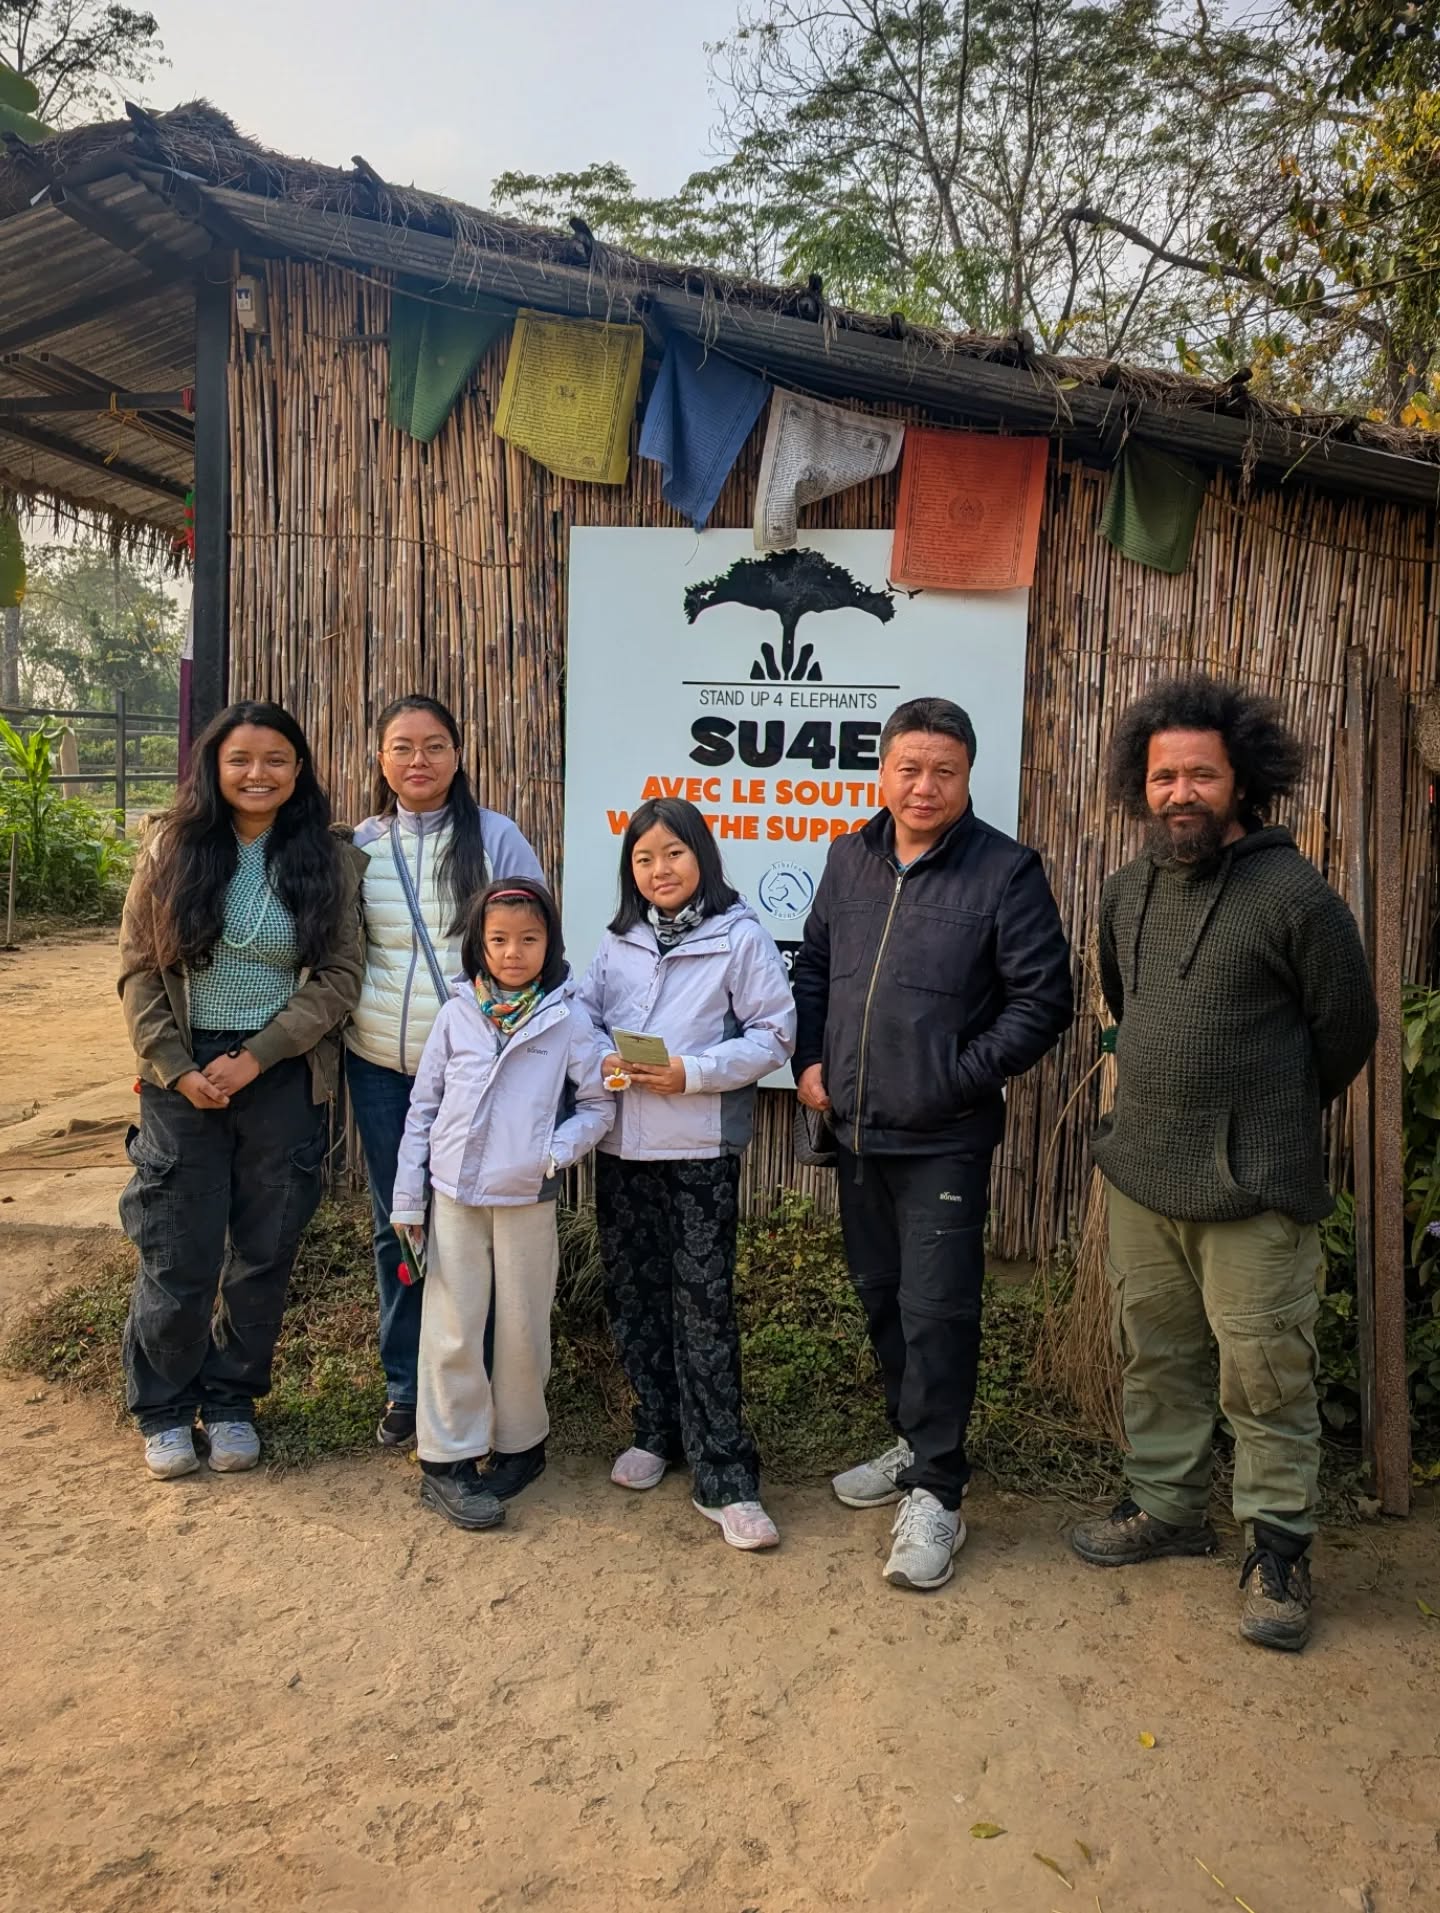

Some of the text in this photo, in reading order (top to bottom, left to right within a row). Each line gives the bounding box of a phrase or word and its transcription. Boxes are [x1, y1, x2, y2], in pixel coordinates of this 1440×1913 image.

[699, 689, 877, 709] STAND UP 4 ELEPHANTS
[689, 716, 881, 770] SU4E
[640, 775, 888, 808] AVEC LE SOUTI
[704, 814, 870, 843] THE SUPP
